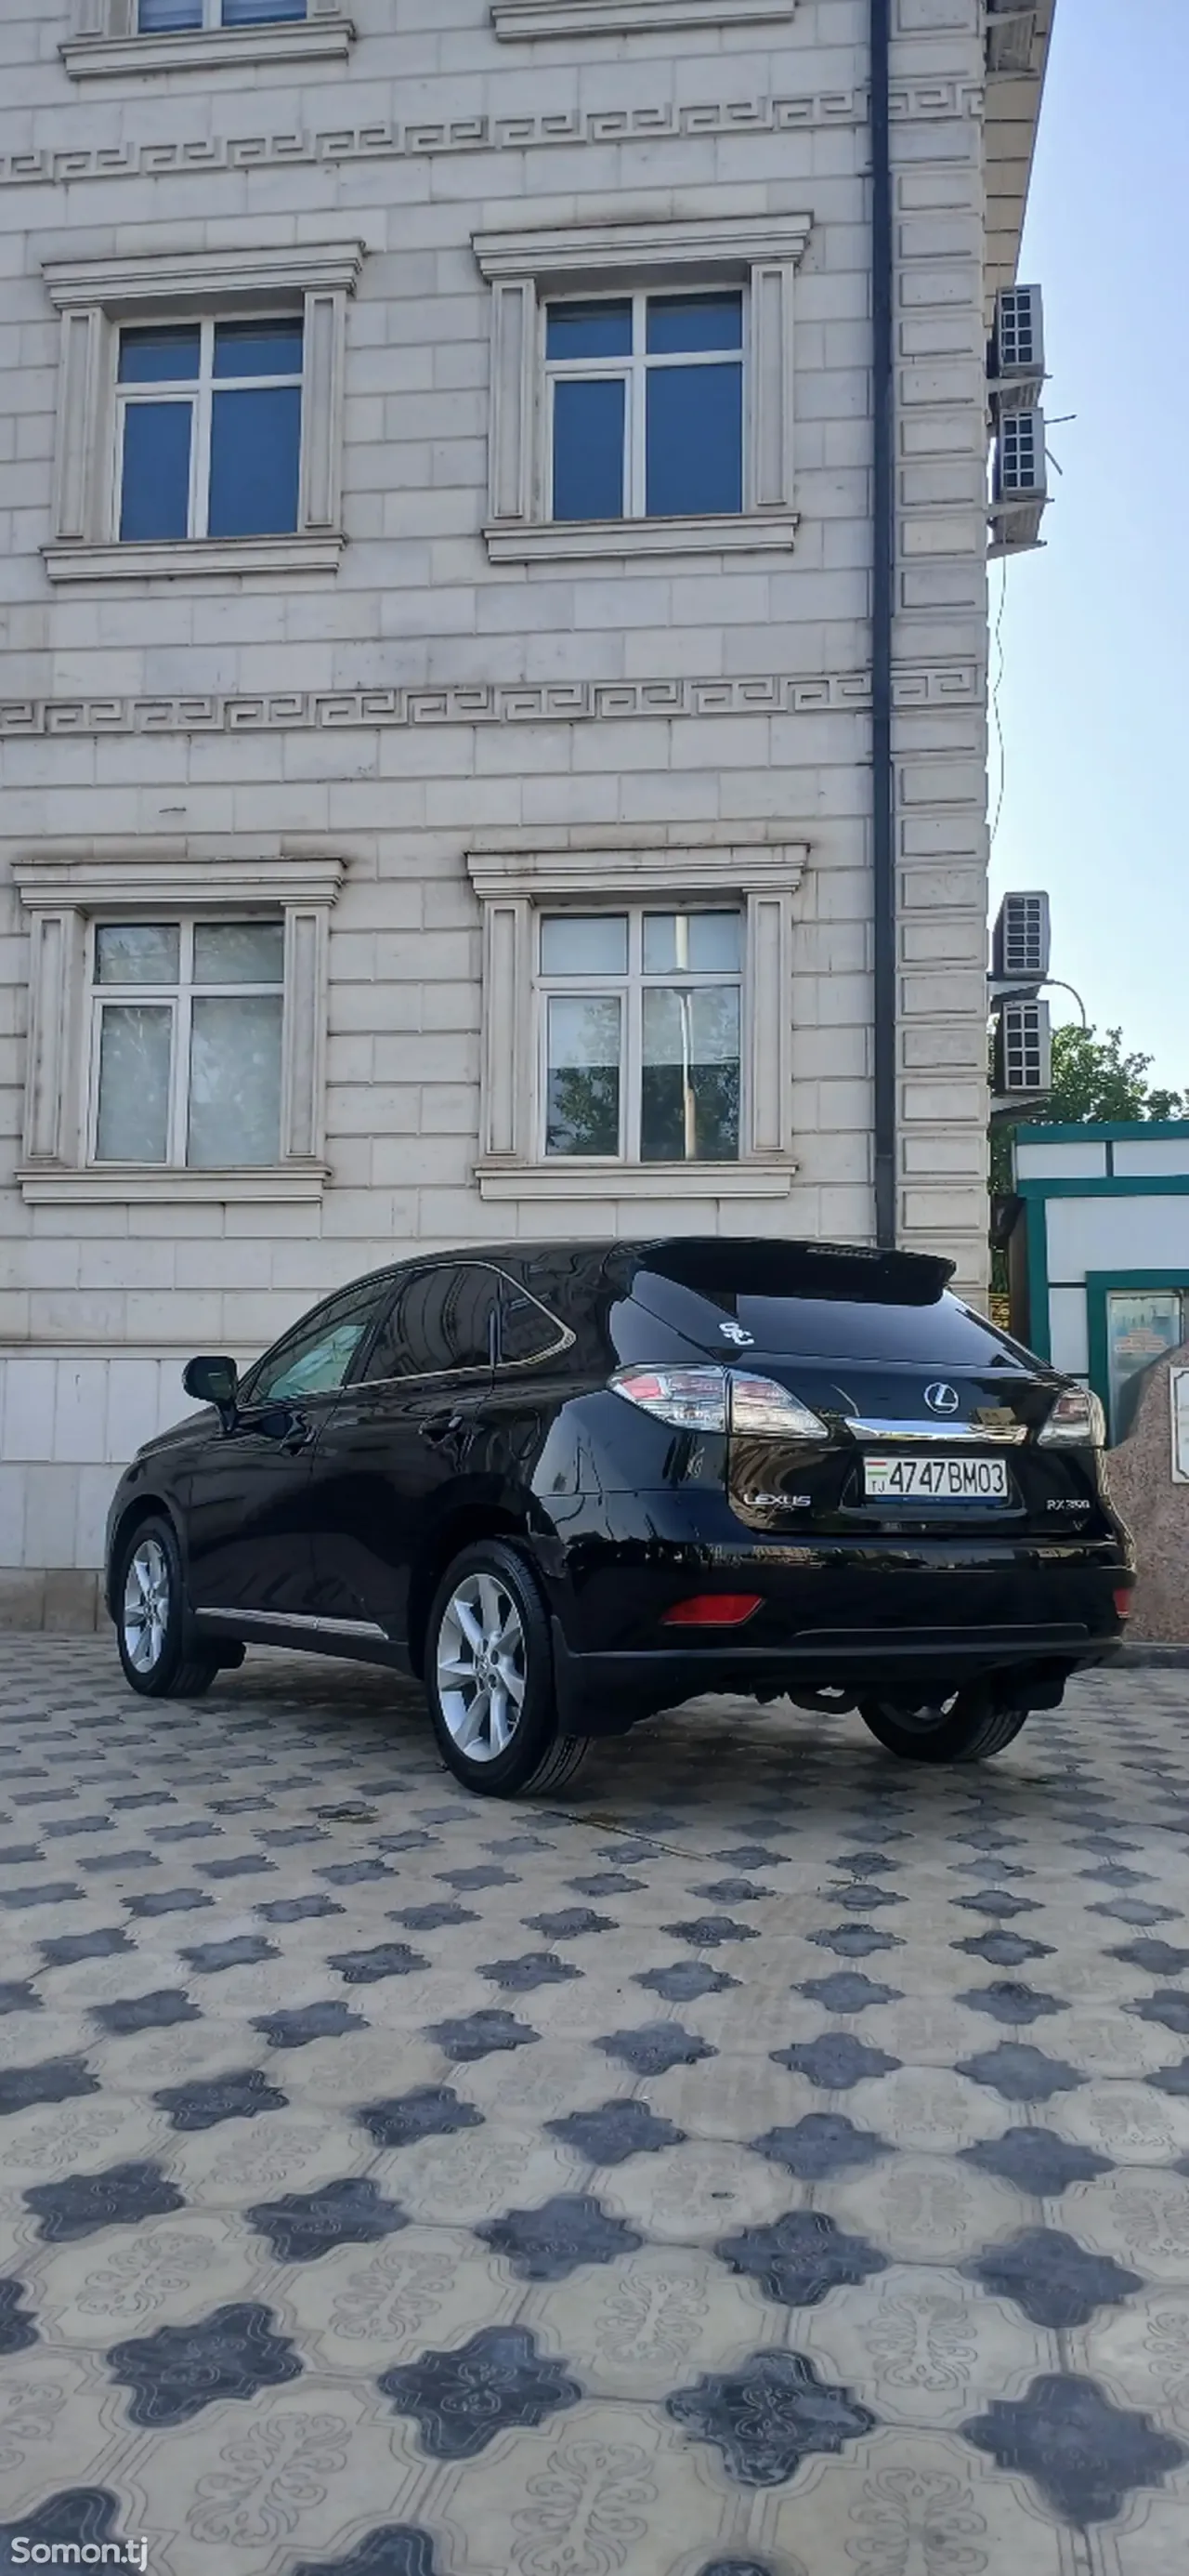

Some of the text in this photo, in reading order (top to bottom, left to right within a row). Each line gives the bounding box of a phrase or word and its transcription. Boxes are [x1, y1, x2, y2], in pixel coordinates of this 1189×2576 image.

[871, 1462, 1004, 1493] TJ 4747BM03
[744, 1493, 811, 1506] LEXUS
[1047, 1499, 1065, 1510] RX
